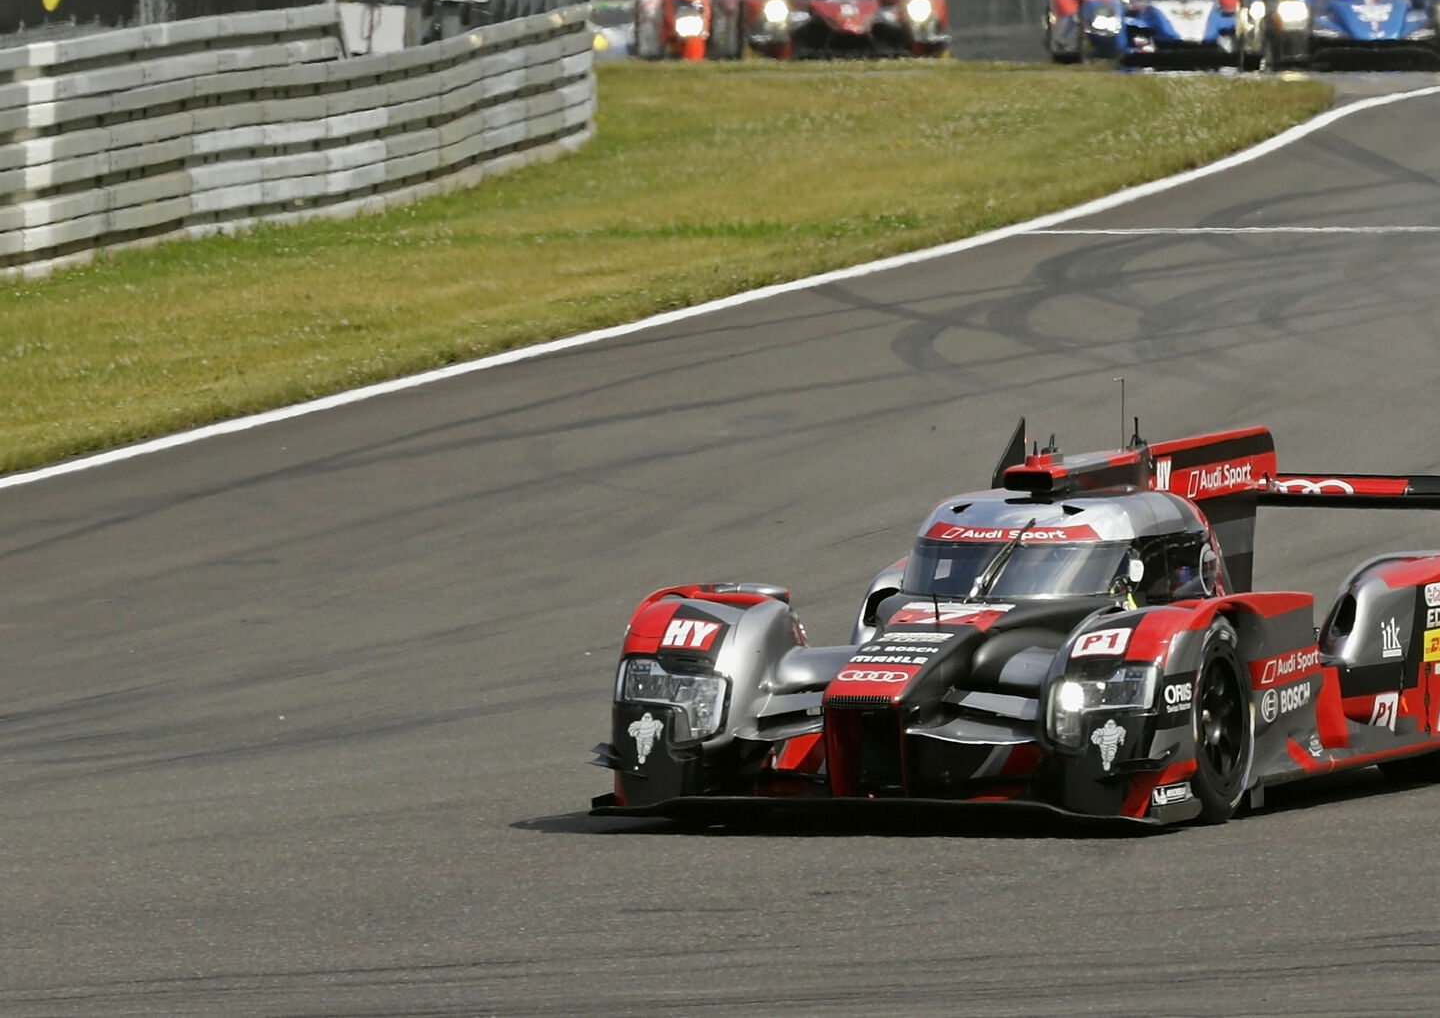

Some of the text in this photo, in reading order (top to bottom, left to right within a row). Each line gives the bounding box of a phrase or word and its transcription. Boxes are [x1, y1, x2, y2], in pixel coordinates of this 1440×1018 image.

[1200, 462, 1251, 490] Audi Sport
[961, 529, 1067, 541] Audi Sport
[661, 620, 718, 647] HY
[1081, 633, 1120, 651] P1
[1381, 616, 1402, 650] itk
[850, 655, 929, 664] MAHLE
[884, 645, 939, 653] BOSCH
[1277, 648, 1319, 677] Audi Sport
[1164, 682, 1193, 705] ORIS
[1281, 682, 1311, 713] BOSCH
